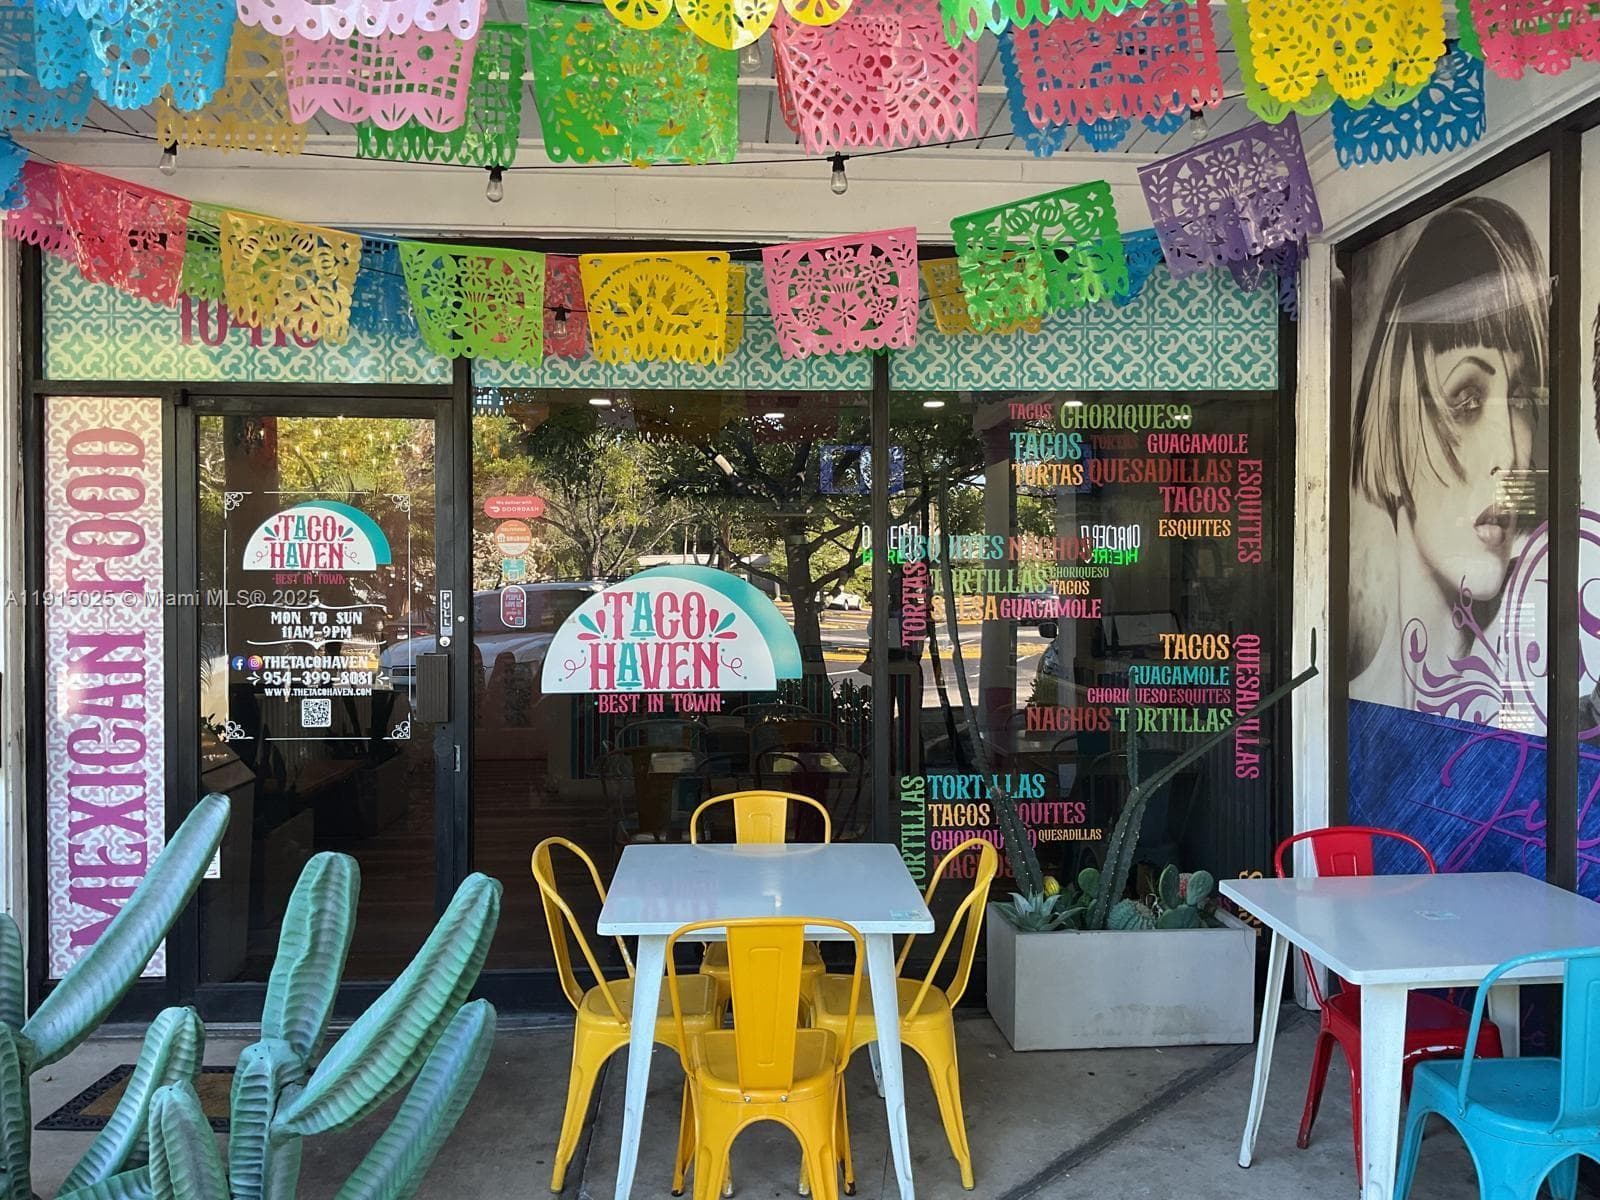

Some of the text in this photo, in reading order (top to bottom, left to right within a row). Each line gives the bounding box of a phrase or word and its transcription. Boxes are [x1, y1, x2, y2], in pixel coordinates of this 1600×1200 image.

[1008, 403, 1053, 420] TACOS
[1060, 404, 1193, 432] CHORIQUESO
[1010, 432, 1084, 460] TACOS
[1147, 433, 1249, 454] GUACAMOLE
[1011, 463, 1084, 486] TORTAS
[1088, 458, 1233, 487] QUESADILLAS
[1159, 486, 1231, 513] TACOS
[1234, 459, 1263, 564] ESQUITES
[278, 515, 338, 542] TACO
[1158, 519, 1232, 539] ESQUITES
[270, 543, 344, 569] HAVEN
[1009, 536, 1093, 561] NACHOS
[276, 574, 345, 585] BEST IN TOWN
[1050, 567, 1110, 579] CHORIQUESO
[1050, 581, 1090, 595] TACOS
[443, 592, 451, 627] PULL
[603, 591, 707, 640] TACO
[902, 561, 928, 647] TORTAS
[930, 595, 999, 620] SLSA
[1000, 599, 1102, 619] GUACAMOLE
[271, 612, 363, 624] MON TO SUN
[282, 626, 353, 639] 11AM-9PM
[1159, 633, 1230, 660] TACOS
[263, 655, 369, 669] THETACOHAVEN
[588, 641, 720, 690] HAVEN
[66, 426, 148, 947] MEXICAN FOOD
[263, 672, 372, 685] 954-399-8081
[1129, 665, 1230, 685] GUACAMOLE
[264, 687, 372, 696] WWW.THETACOHAVEN.COM
[599, 694, 721, 713] BEST IN TOWN
[1169, 688, 1231, 706] ESQUITES
[1026, 706, 1112, 732] NACHOS
[928, 803, 991, 827] TACOS
[995, 802, 1086, 828] QUITES
[900, 775, 926, 891] ORTILLAS
[1038, 828, 1103, 843] QUESADILLAS
